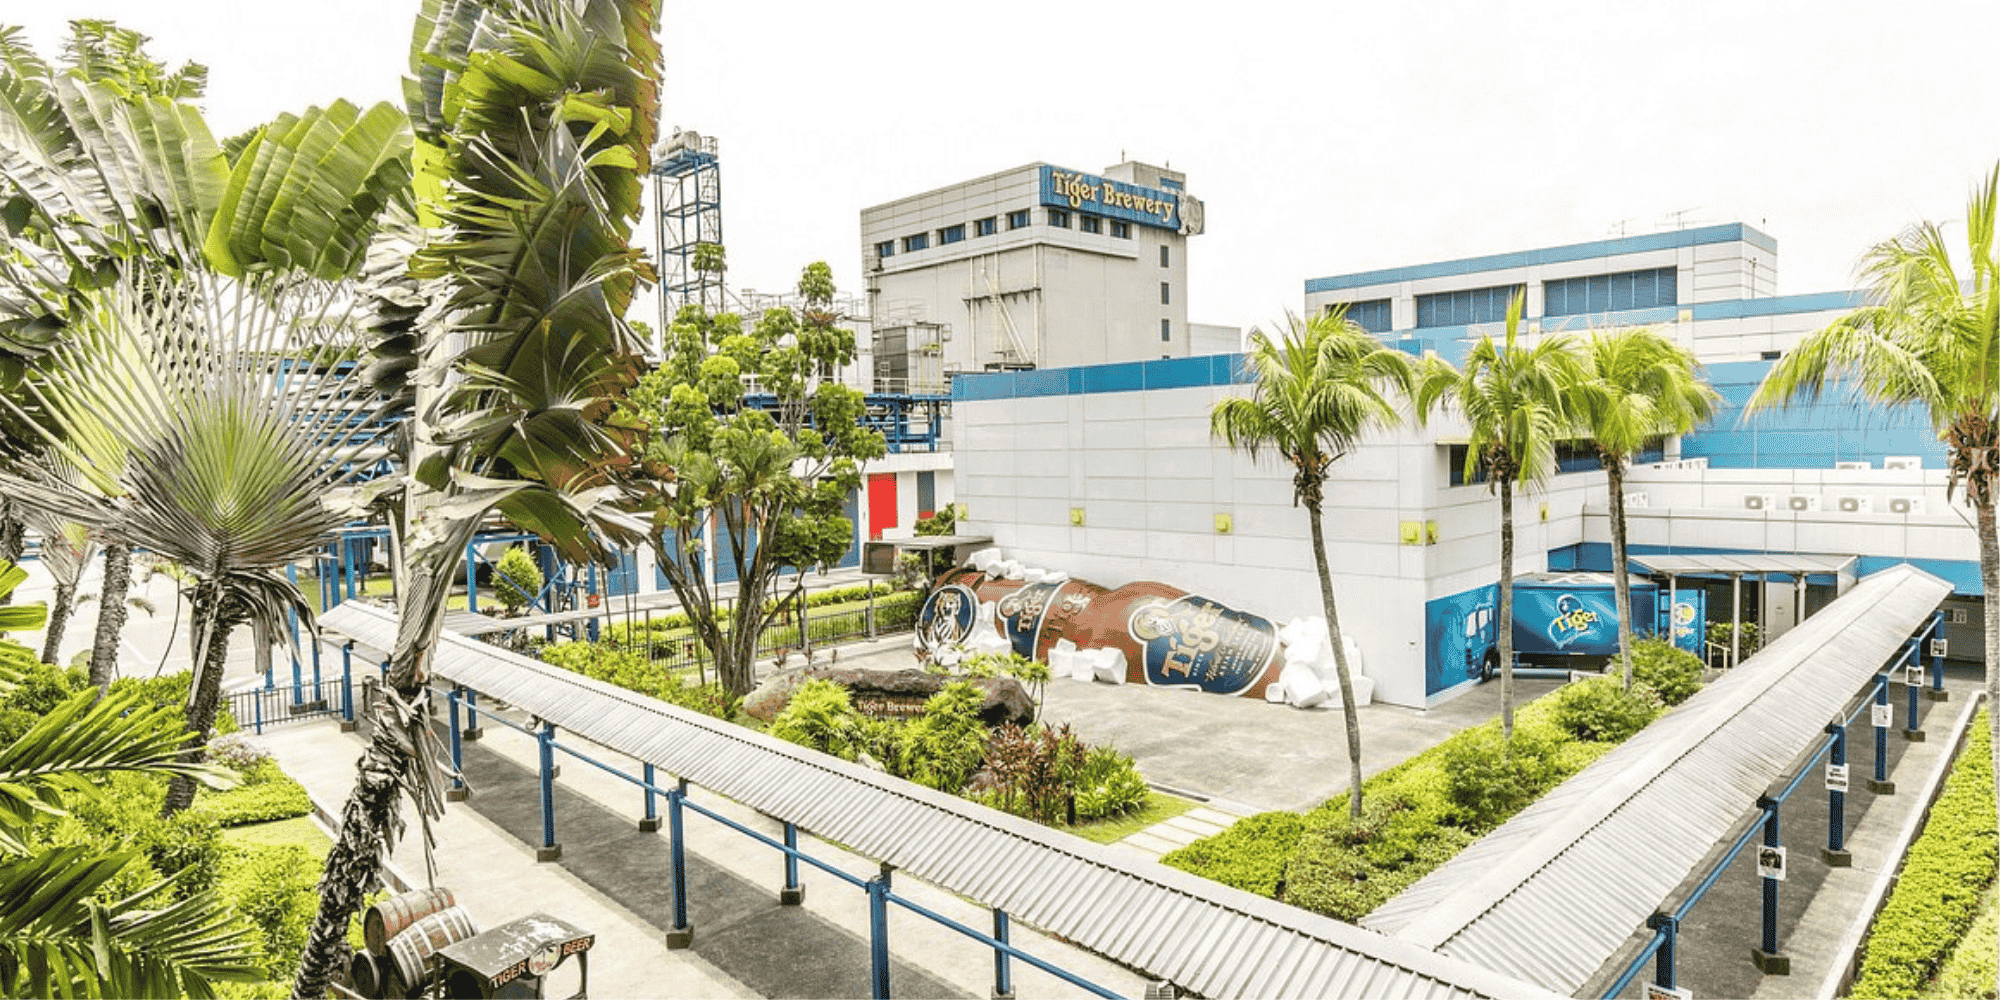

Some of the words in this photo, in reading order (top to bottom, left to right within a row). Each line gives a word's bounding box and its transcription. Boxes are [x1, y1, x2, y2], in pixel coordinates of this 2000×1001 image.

[1053, 171, 1098, 208] Tiger
[1103, 183, 1174, 222] Brewery
[1161, 601, 1224, 678] Tiger
[1555, 609, 1597, 632] Tiger
[887, 701, 926, 713] Brewer
[489, 960, 526, 988] TIGER
[563, 937, 590, 955] BEER
